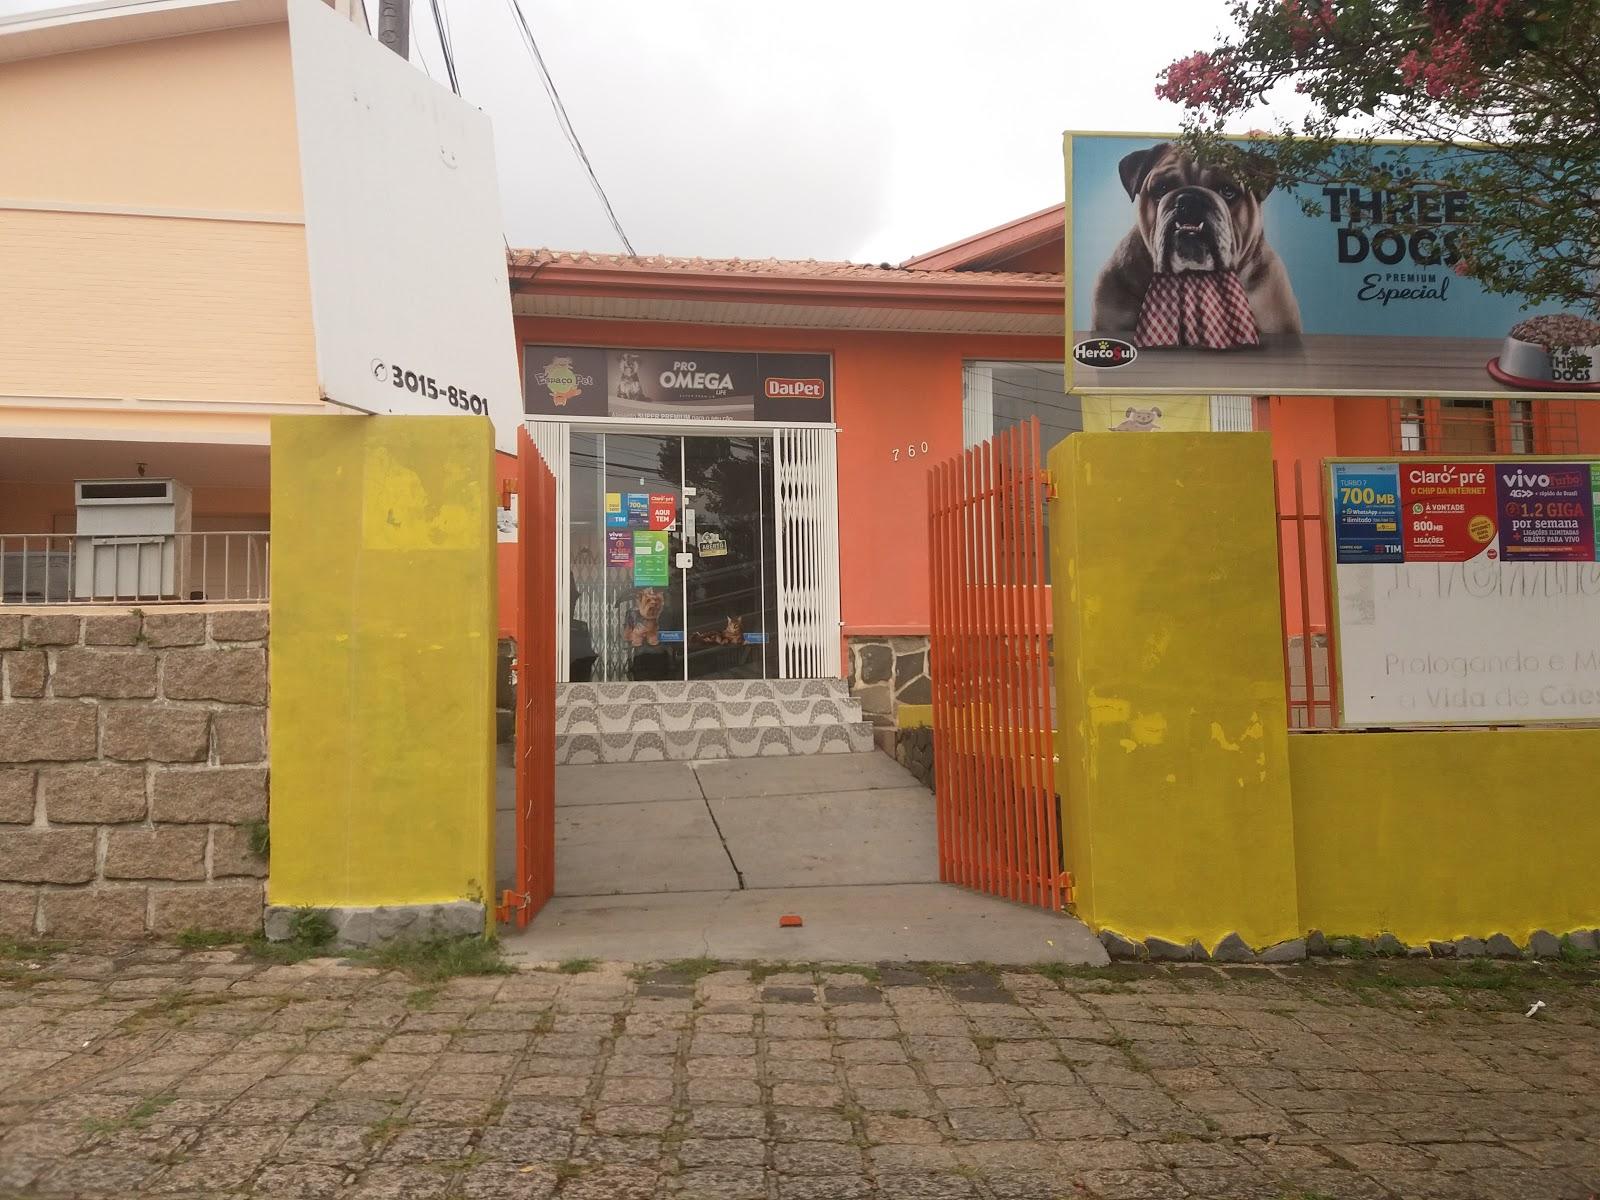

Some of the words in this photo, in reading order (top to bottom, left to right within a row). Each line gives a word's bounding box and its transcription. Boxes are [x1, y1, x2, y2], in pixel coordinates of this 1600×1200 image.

[1322, 188, 1470, 226] THREE
[1386, 273, 1437, 283] PREMIUM
[1357, 273, 1450, 307] Especial
[1075, 345, 1134, 361] HercoSul
[673, 361, 697, 371] PRO
[576, 374, 593, 386] Pet
[660, 371, 734, 390] OMEGA
[1552, 369, 1591, 381] DOGS
[392, 365, 489, 416] 3015-8501
[1459, 468, 1485, 486] pré
[1503, 469, 1550, 487] vivo
[1341, 488, 1375, 504] 700
[1376, 494, 1395, 504] MB
[1417, 487, 1435, 495] CHIP
[1436, 487, 1448, 495] DA
[1448, 487, 1486, 495] INTERNET
[1521, 503, 1543, 517] 1.2
[1547, 503, 1584, 517] GIGA
[1512, 520, 1532, 531] por
[1535, 520, 1579, 528] semana
[1413, 536, 1445, 544] LIGAÇÕES
[1523, 535, 1546, 543] GRÁTIS
[1384, 545, 1402, 553] TIM
[1427, 686, 1486, 708] Vida
[1495, 685, 1529, 707] de
